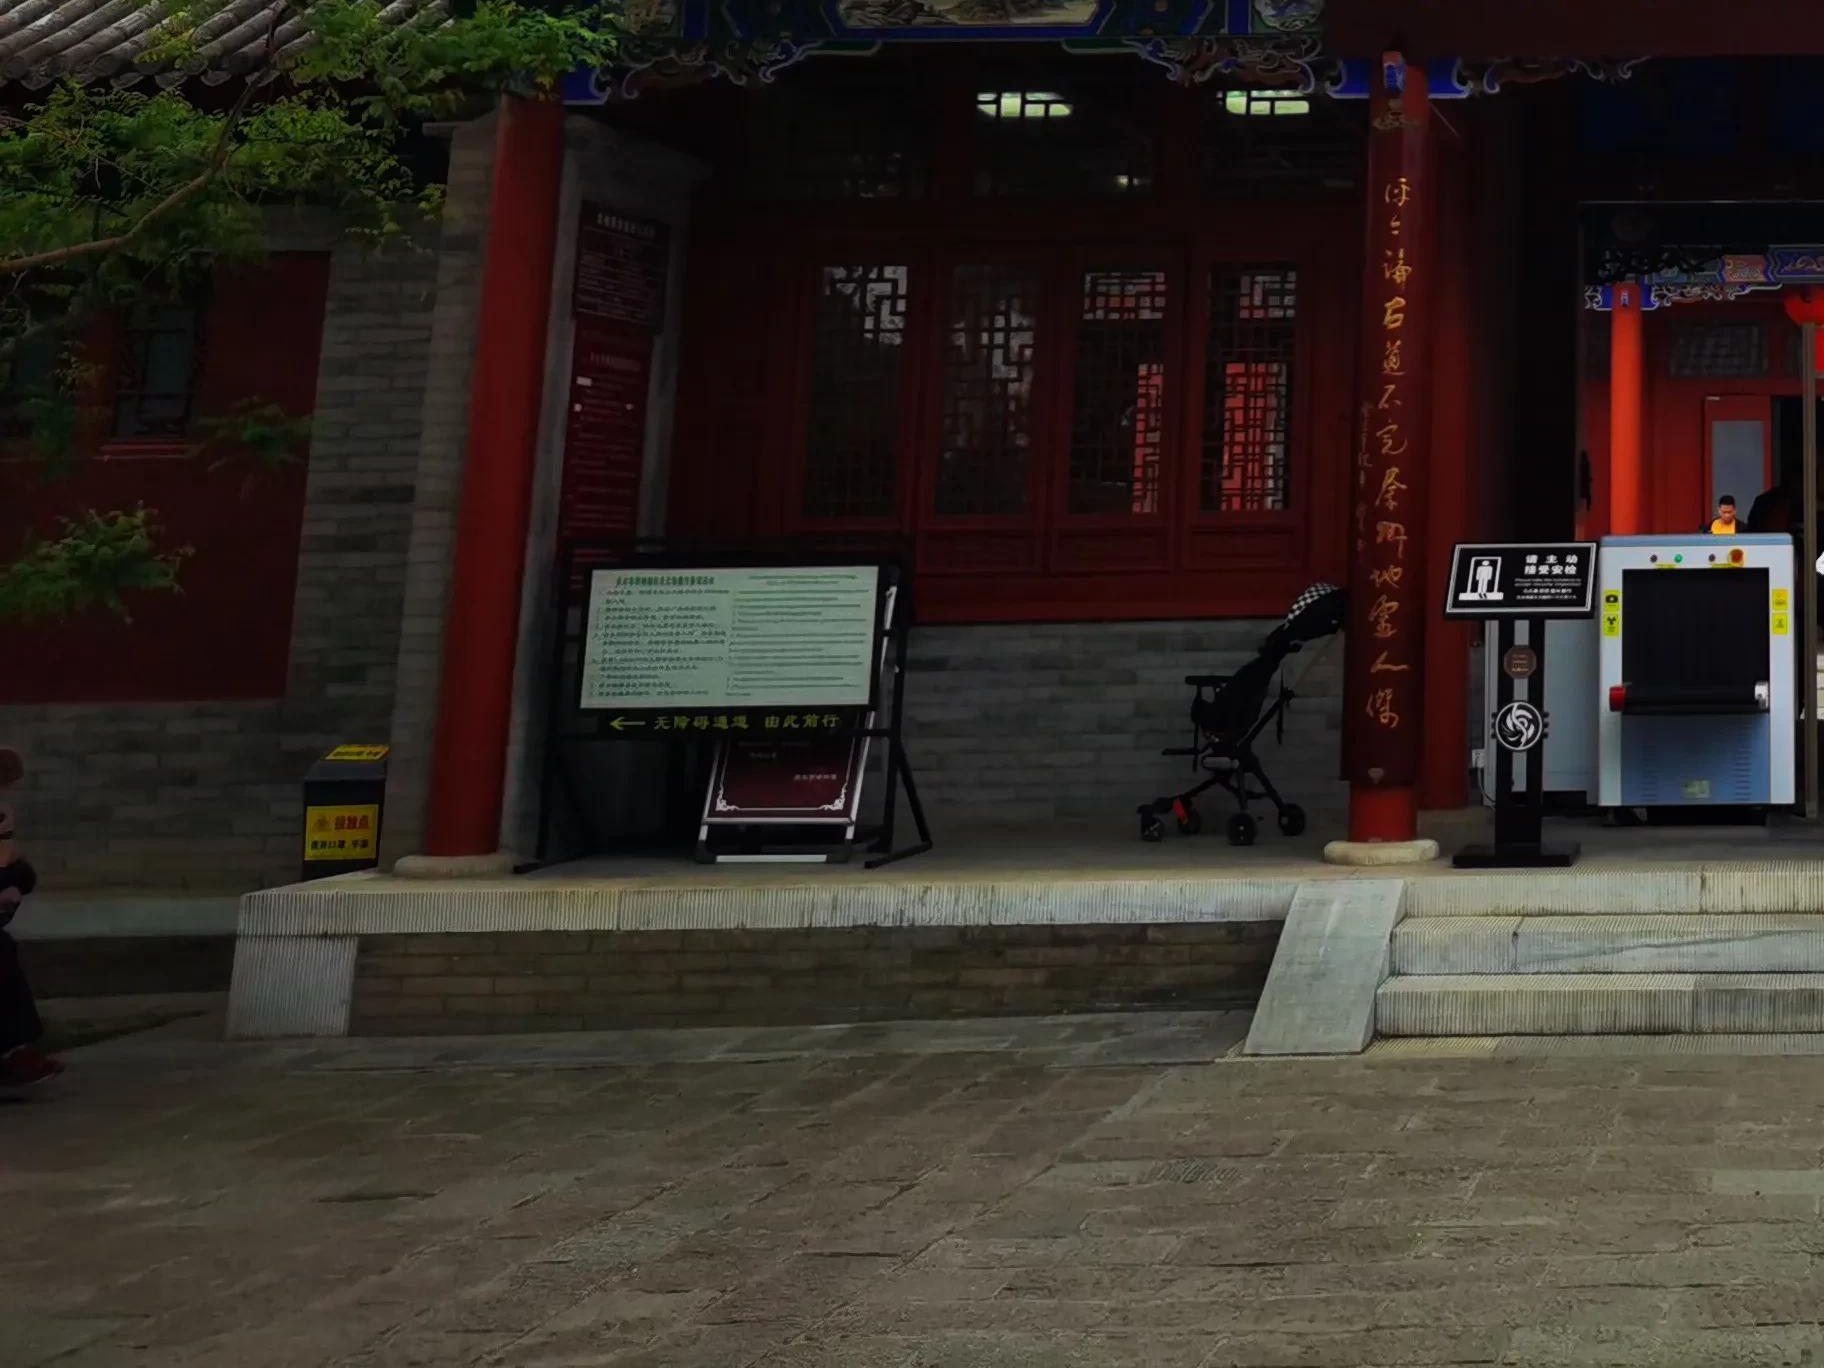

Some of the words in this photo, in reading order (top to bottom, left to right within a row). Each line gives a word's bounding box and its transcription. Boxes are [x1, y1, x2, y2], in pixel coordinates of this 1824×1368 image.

[653, 714, 750, 731] 无障碍通道
[764, 713, 841, 729] 由此前行
